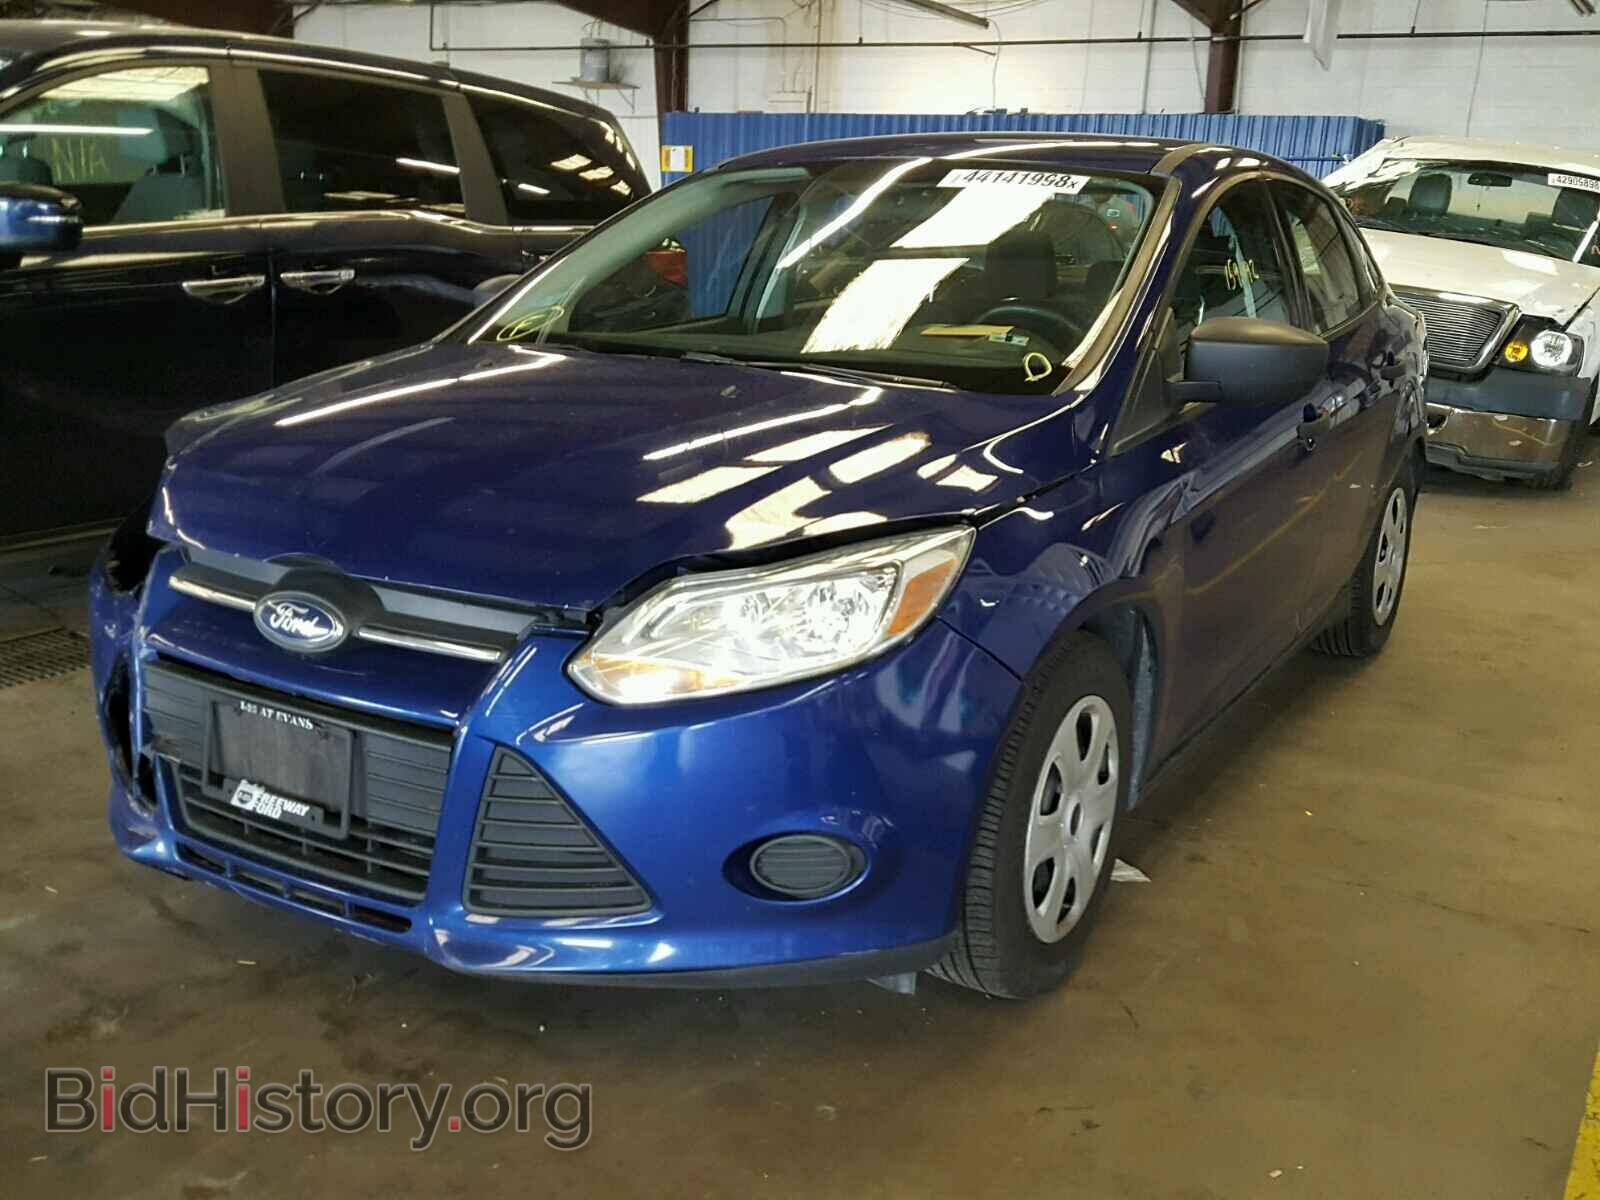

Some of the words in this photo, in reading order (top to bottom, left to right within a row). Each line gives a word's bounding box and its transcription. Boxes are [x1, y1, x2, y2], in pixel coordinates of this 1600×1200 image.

[267, 600, 329, 637] Ford
[260, 707, 275, 719] AT
[275, 710, 315, 730] EVANS
[258, 790, 310, 817] FREEWAY
